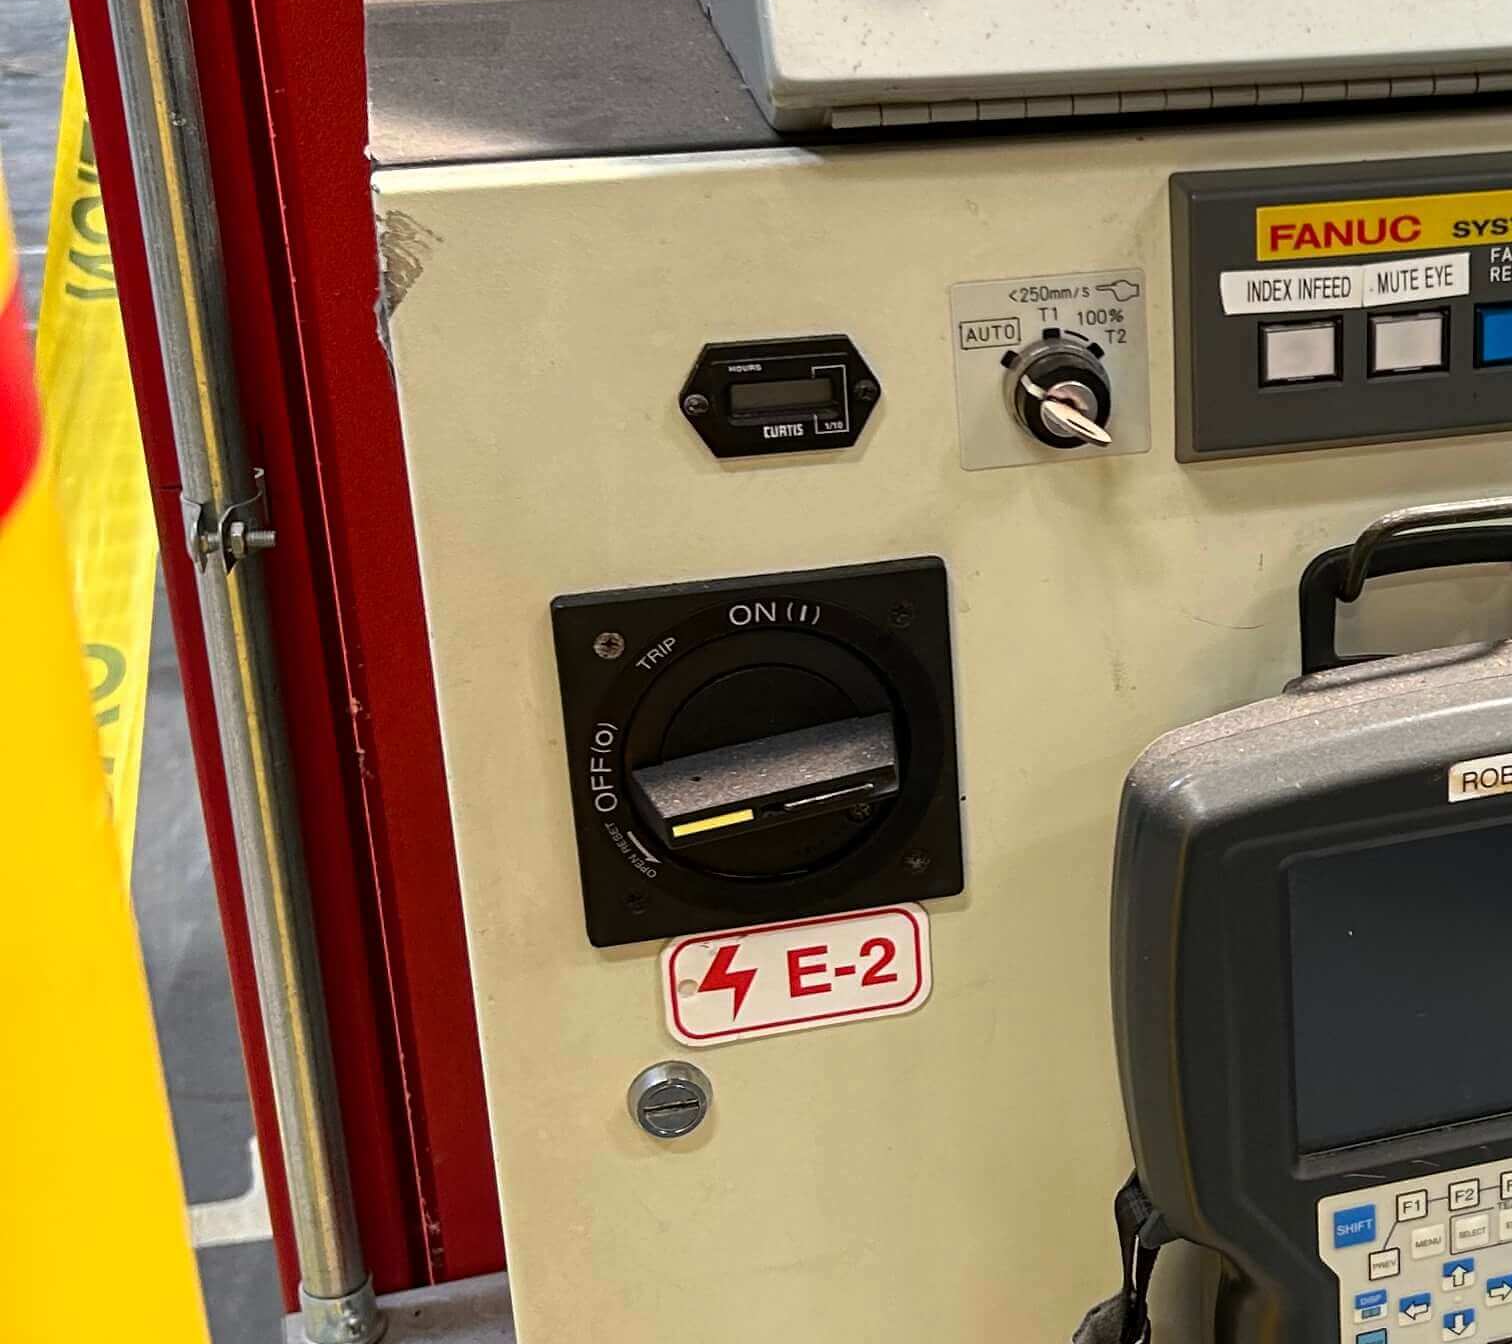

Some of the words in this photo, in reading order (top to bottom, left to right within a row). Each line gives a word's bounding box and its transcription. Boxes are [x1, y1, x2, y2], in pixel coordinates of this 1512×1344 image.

[1269, 214, 1422, 252] FANUC
[1246, 276, 1292, 303] INDEX
[1299, 274, 1352, 301] INFEED
[1377, 269, 1419, 295] MUTE
[1424, 264, 1454, 290] EYE
[1037, 306, 1059, 322] T1
[1077, 308, 1124, 325] 100%
[966, 323, 1016, 343] AUTO
[1105, 328, 1128, 346] T2
[728, 363, 763, 373] HOURS
[763, 423, 804, 439] CURTIS
[729, 602, 776, 626] ON
[635, 636, 677, 673] TRIP
[787, 937, 898, 999] E-2
[1455, 1188, 1474, 1203] F2
[1402, 1199, 1421, 1214] F1
[1336, 1218, 1373, 1236] SHIFT
[1415, 1236, 1442, 1248] MENU
